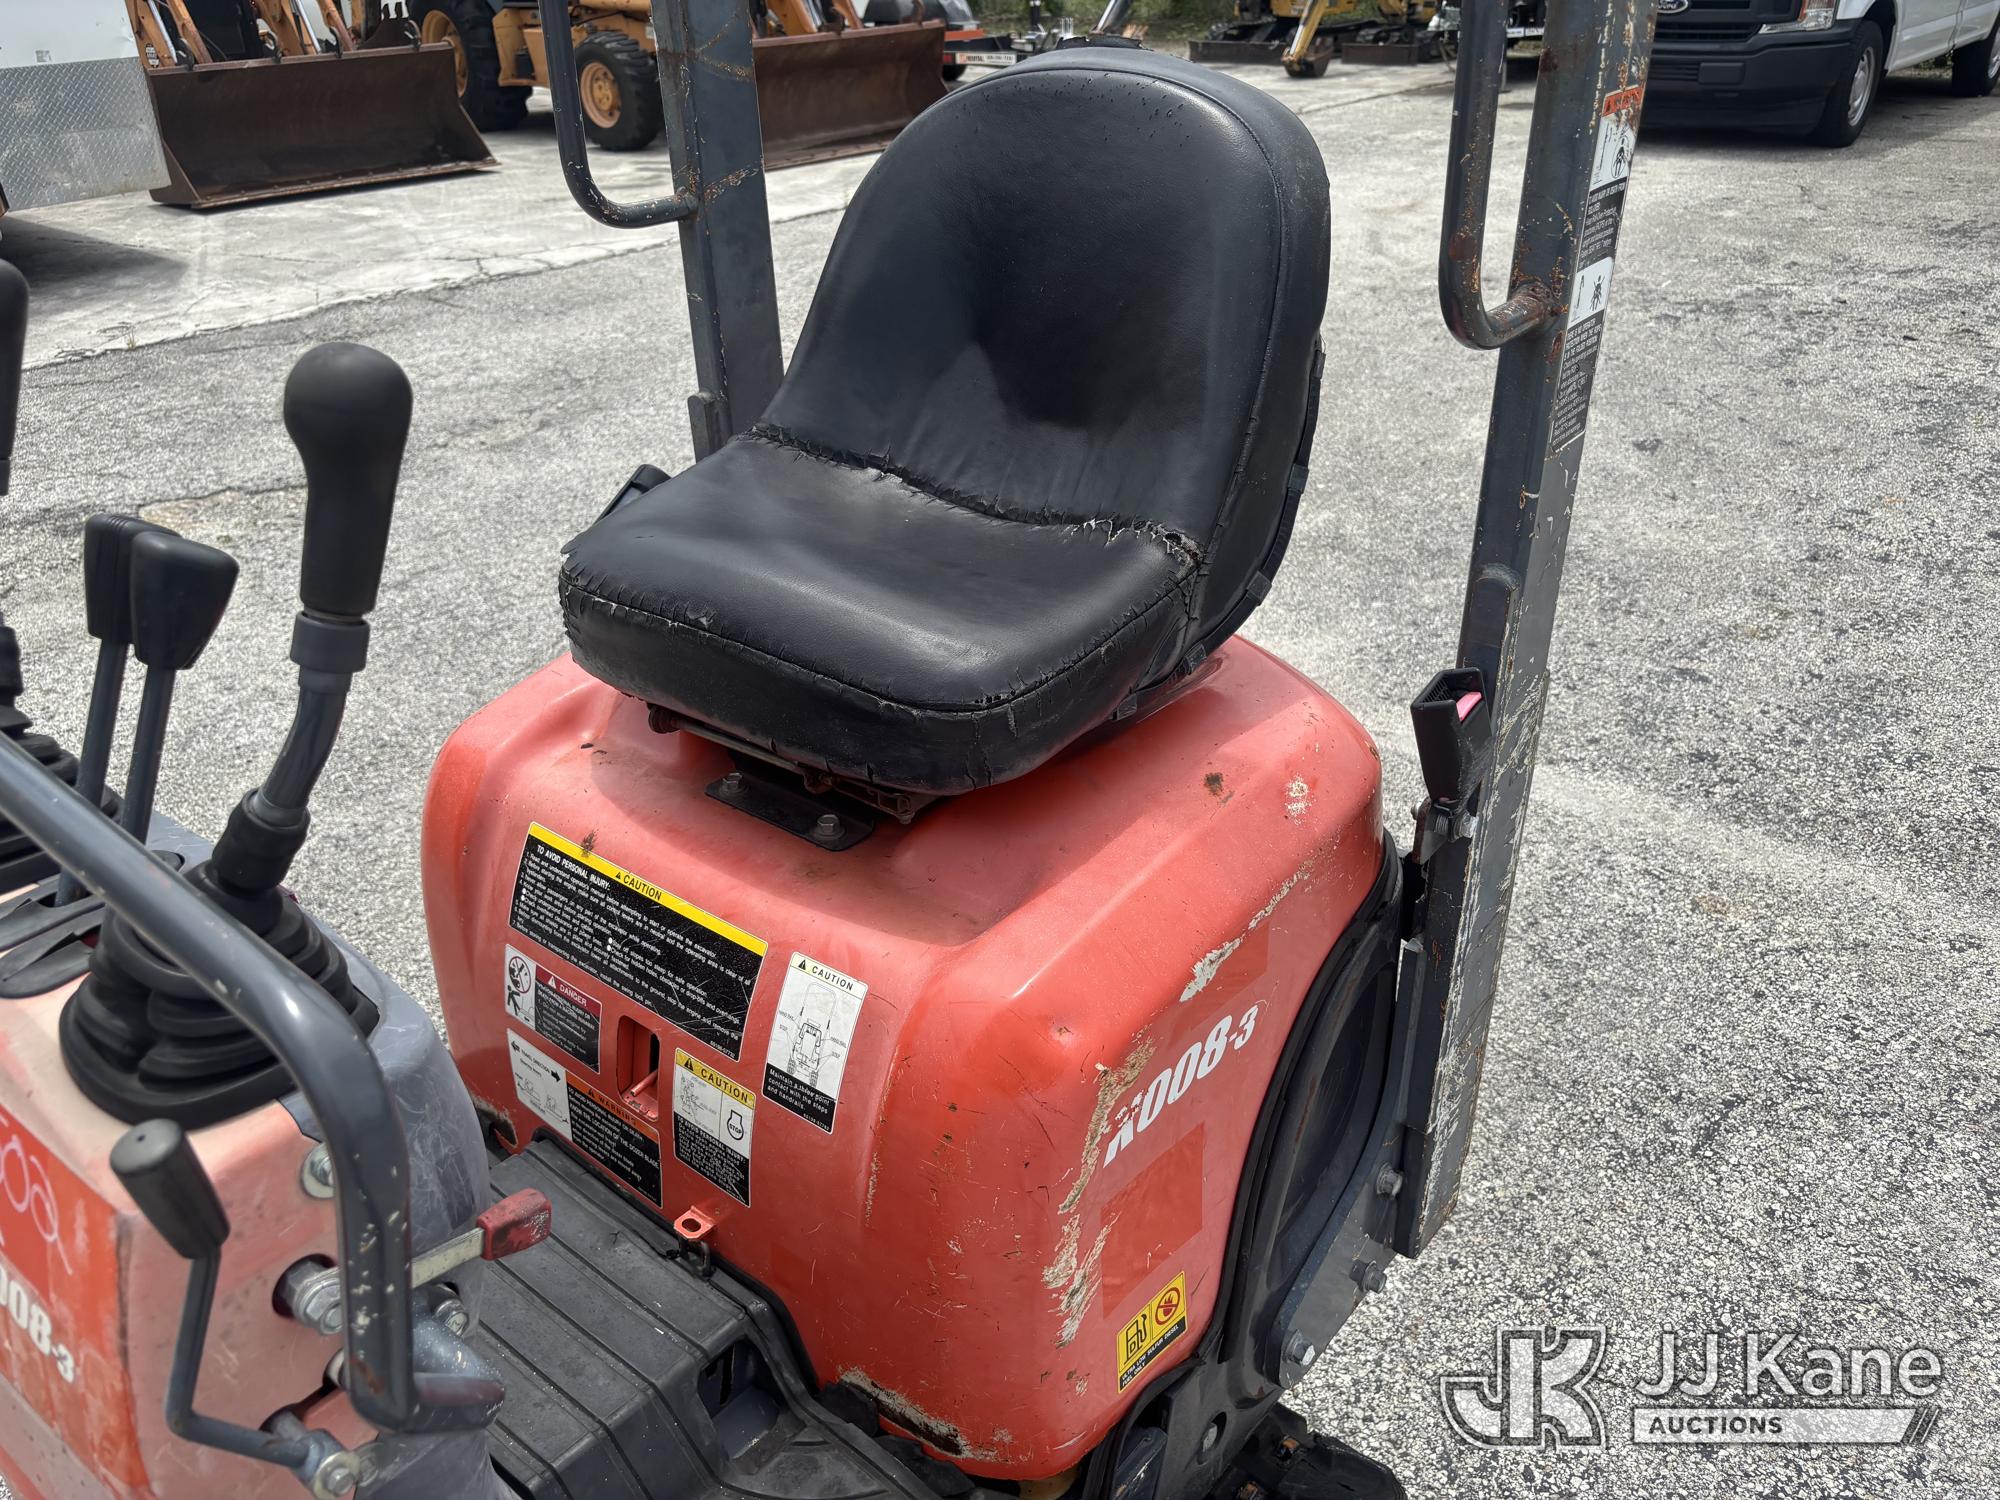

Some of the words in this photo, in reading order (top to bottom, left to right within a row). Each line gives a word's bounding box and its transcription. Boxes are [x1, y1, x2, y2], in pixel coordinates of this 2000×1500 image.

[536, 845, 544, 855] TO
[544, 849, 561, 864] AVOID
[561, 858, 588, 878] PERSONAL
[589, 872, 611, 890] INJURY:
[623, 874, 661, 900] CAUTION
[811, 964, 853, 991] CAUTION
[559, 982, 586, 1007] DANGER
[701, 1067, 747, 1103] CAUTION
[767, 1084, 778, 1095] and
[769, 1067, 793, 1086] Maintain
[767, 1076, 788, 1093] contact
[789, 1088, 801, 1100] with
[801, 1095, 811, 1105] the
[812, 1101, 828, 1114] steps
[729, 1123, 742, 1134] STOP
